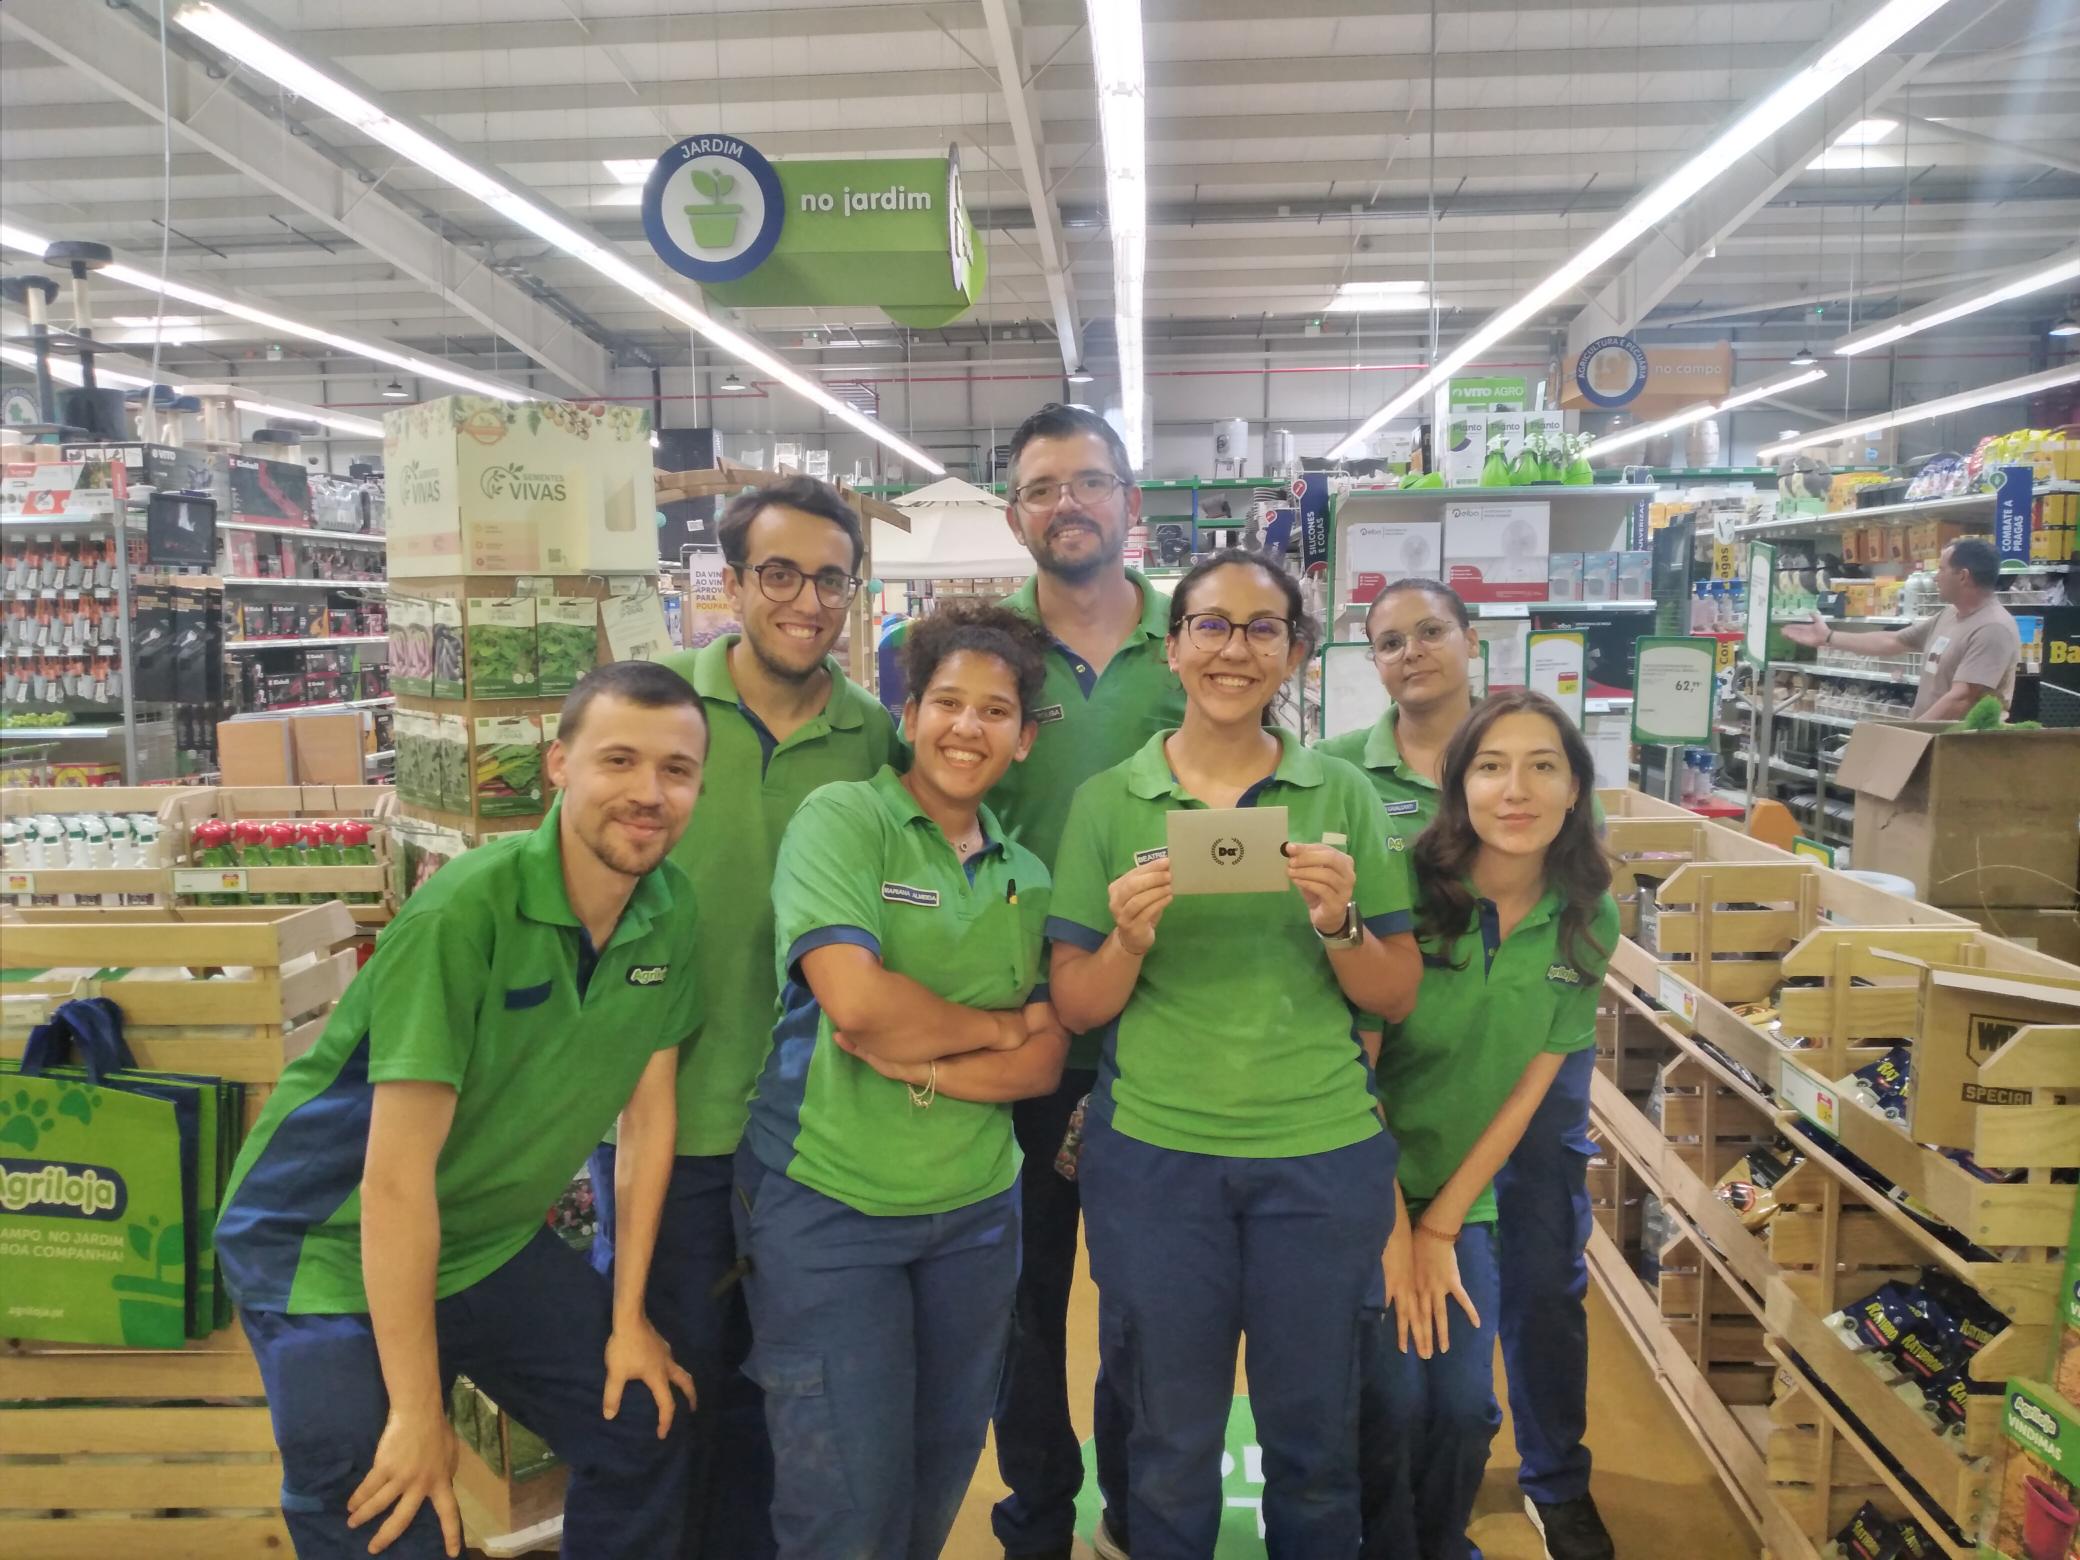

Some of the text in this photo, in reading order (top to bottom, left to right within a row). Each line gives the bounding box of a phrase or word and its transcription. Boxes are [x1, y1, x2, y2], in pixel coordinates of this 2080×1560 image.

[681, 138, 744, 159] JARDIM
[801, 185, 932, 217] no jardim
[1578, 337, 1619, 379] AGRICULTURA
[1619, 338, 1626, 346] E
[1655, 363, 1722, 376] no campo
[1463, 386, 1524, 397] VITO AGRO
[412, 480, 441, 504] VIVAS
[509, 482, 567, 502] VIVAS
[1307, 511, 1317, 555] SILICONES
[1316, 517, 1325, 547] COLAS
[2002, 499, 2014, 552] COMBATE A
[2012, 515, 2024, 552] PRAGAS
[695, 570, 707, 578] DA
[1137, 850, 1168, 864] BEATRIZ
[884, 886, 911, 897] MARIANA
[48, 1230, 71, 1244] NO
[73, 1231, 125, 1248] JARDIM
[2008, 1412, 2063, 1462] VINDIMAS
